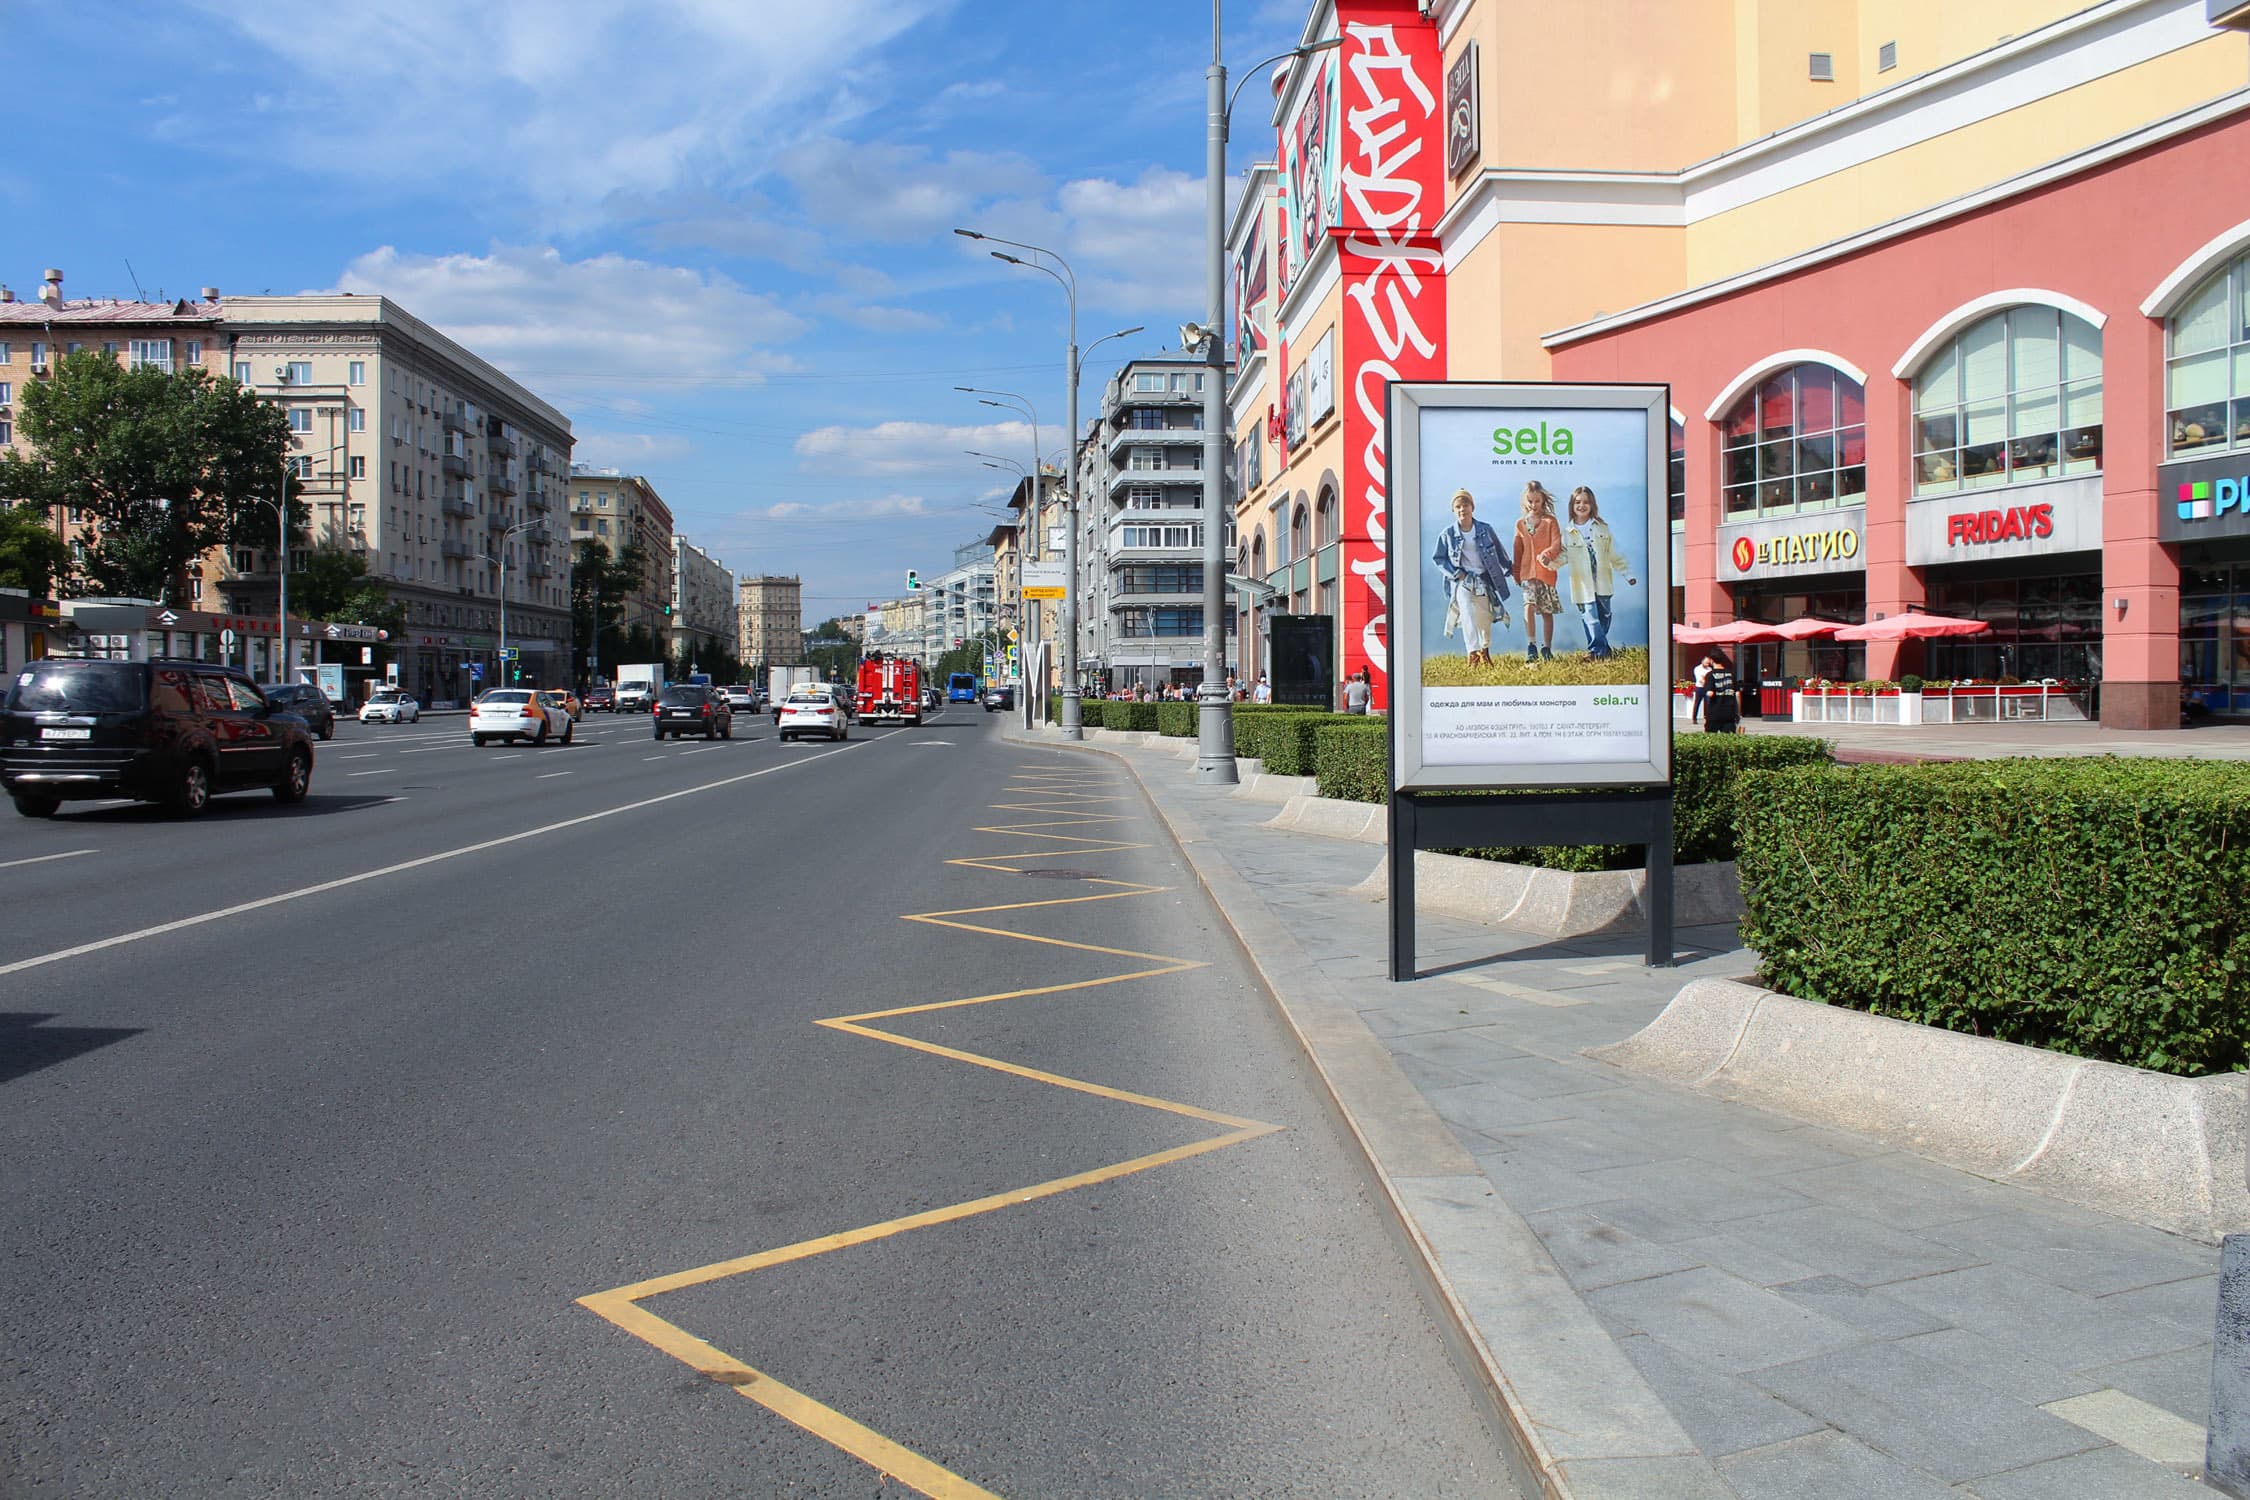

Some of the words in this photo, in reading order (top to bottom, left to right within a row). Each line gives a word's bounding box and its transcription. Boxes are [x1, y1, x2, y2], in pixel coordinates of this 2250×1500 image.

[1492, 421, 1574, 456] sela
[1947, 503, 2054, 547] FRIDAYS
[1771, 528, 1859, 565] ПАТИО
[1430, 700, 1459, 708] одежда
[1460, 700, 1475, 708] для
[1501, 698, 1538, 707] любимых
[1539, 699, 1576, 708] монстров
[1592, 694, 1638, 706] sela.ru
